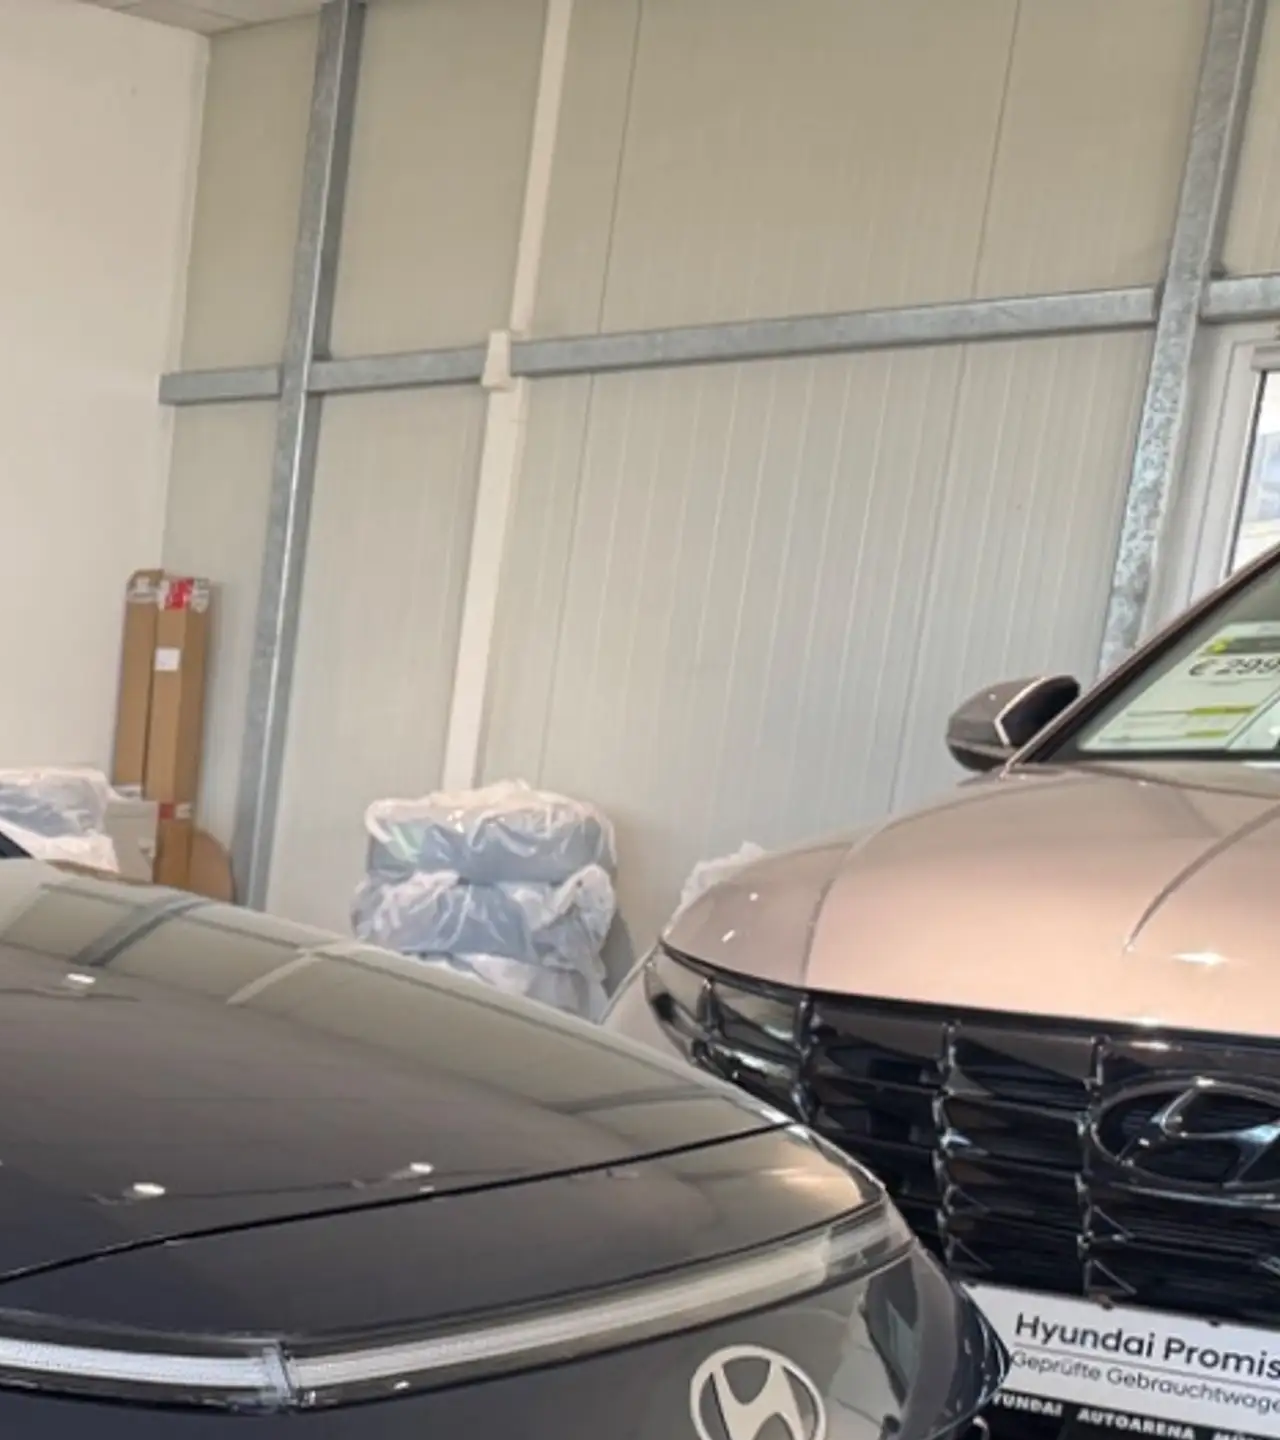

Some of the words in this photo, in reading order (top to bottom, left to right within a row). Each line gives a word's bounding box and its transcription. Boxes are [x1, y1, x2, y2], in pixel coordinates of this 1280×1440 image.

[1010, 1349, 1102, 1381] Geprüfte
[1014, 1311, 1155, 1359] Hyundai
[1163, 1336, 1280, 1380] Promis
